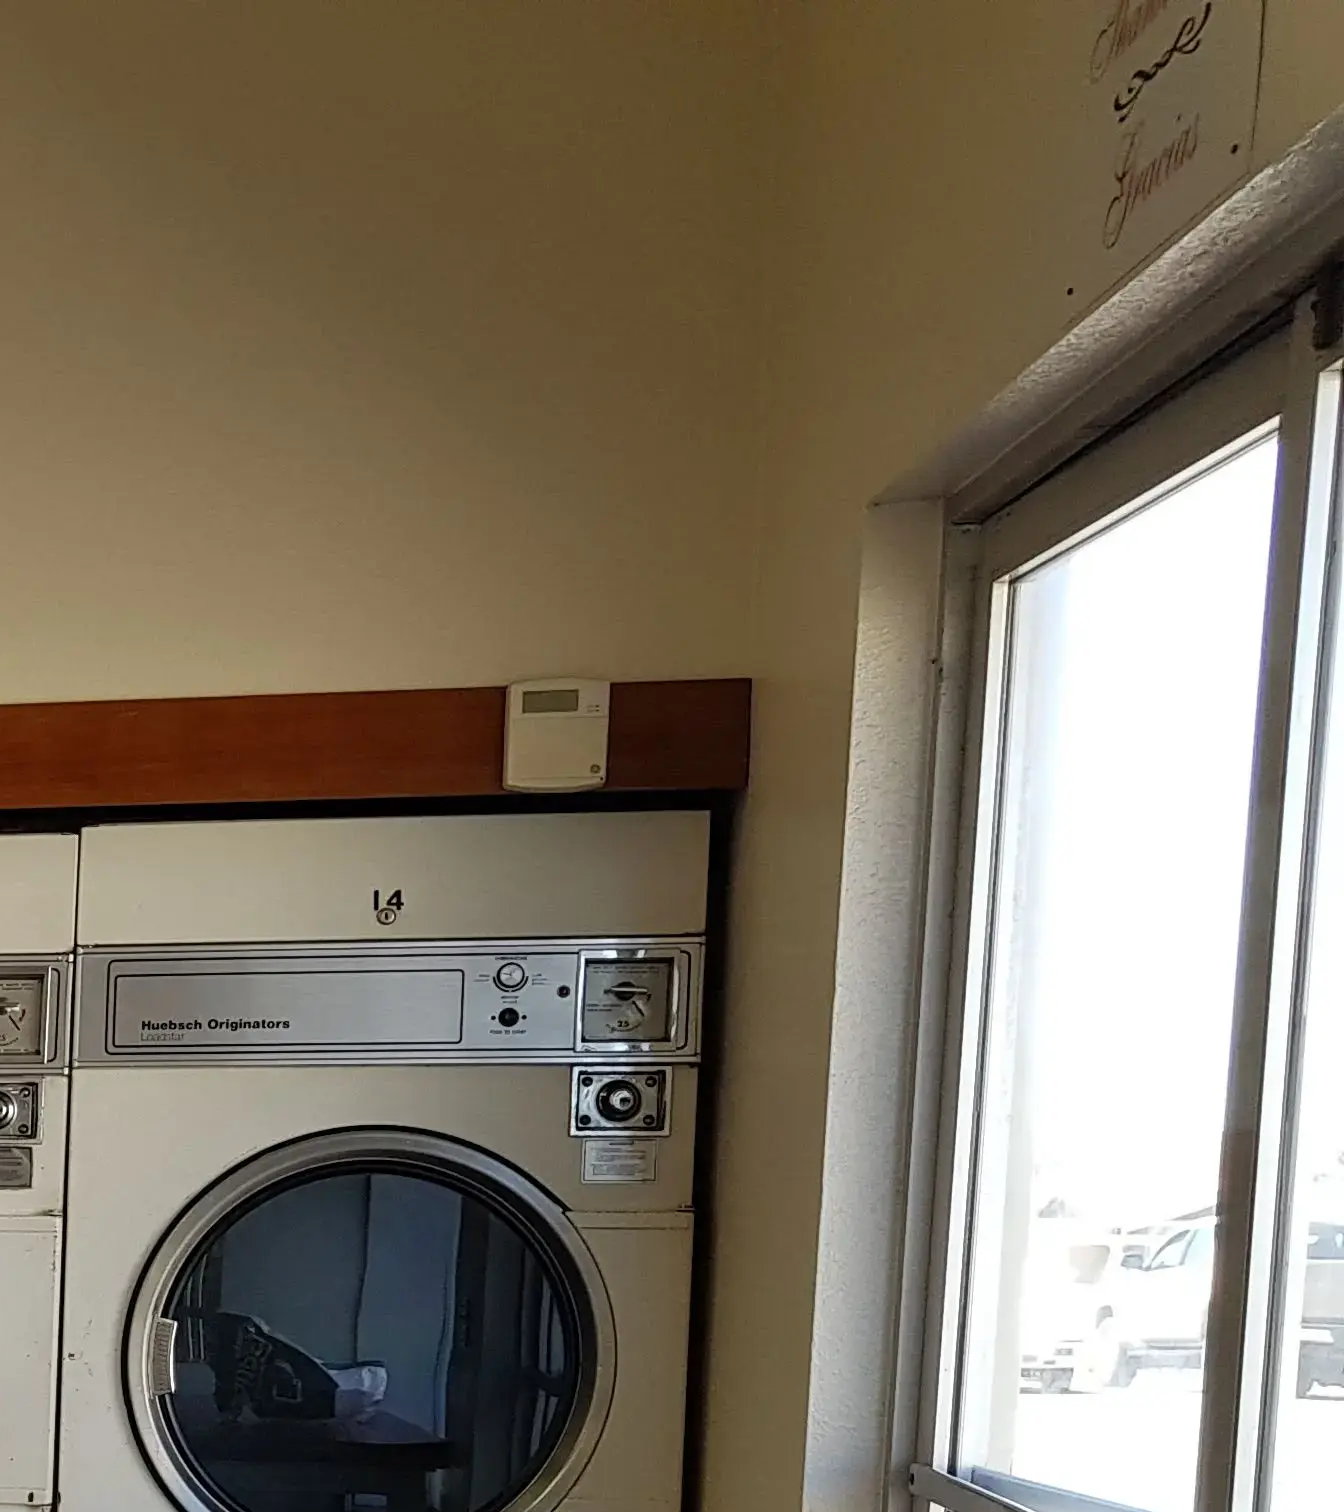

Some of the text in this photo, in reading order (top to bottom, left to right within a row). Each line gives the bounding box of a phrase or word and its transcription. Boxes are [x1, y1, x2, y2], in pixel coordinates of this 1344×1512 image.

[373, 888, 405, 913] 14
[141, 1018, 291, 1031] Huebsch Originators
